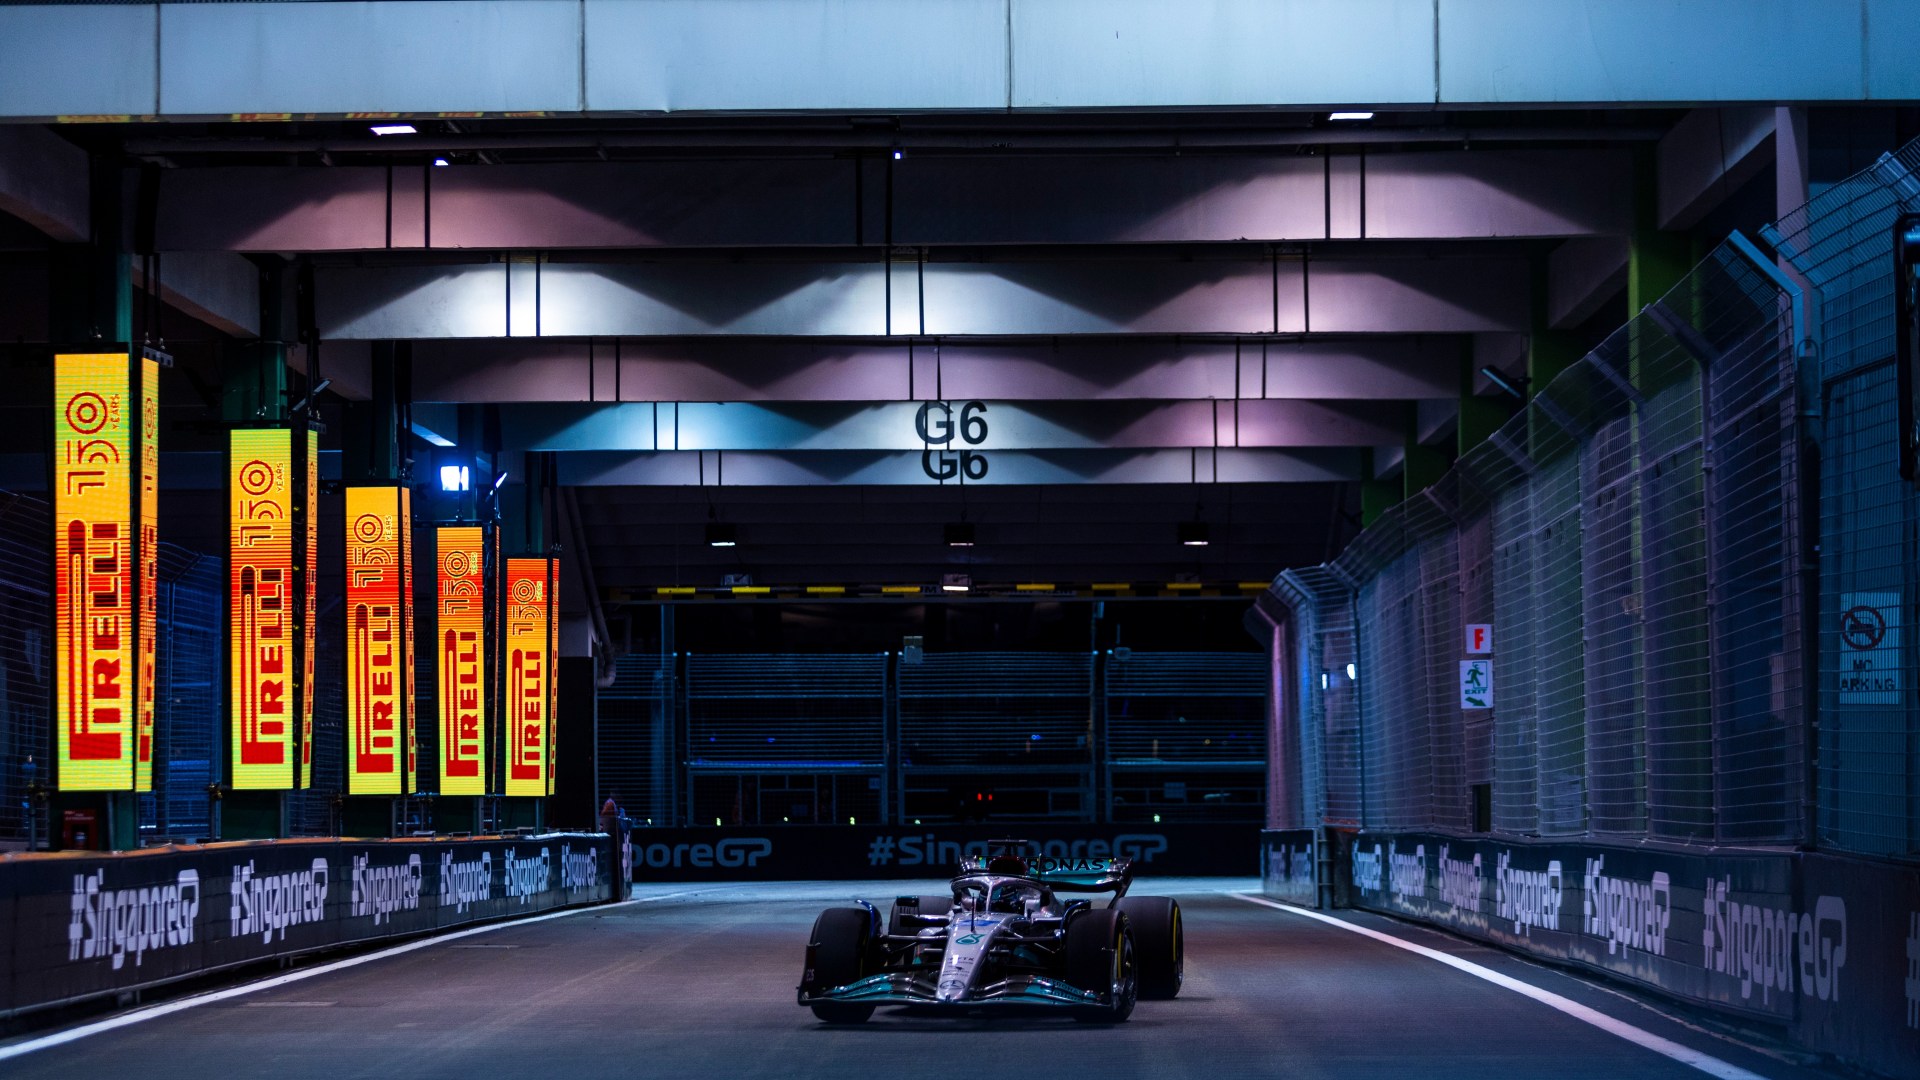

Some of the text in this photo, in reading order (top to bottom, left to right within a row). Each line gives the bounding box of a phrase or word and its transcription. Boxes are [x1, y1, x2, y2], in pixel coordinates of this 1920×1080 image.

[66, 391, 120, 495] 150
[109, 393, 121, 430] YEARS
[915, 401, 988, 445] G6
[275, 462, 285, 493] YEARS
[922, 450, 988, 480] G6
[68, 520, 122, 760] PIRELLI
[240, 459, 285, 764] PIRELLI 150
[353, 513, 393, 773] PIRELLI 150
[1475, 628, 1484, 650] F
[443, 550, 479, 776] PIRELLI 150
[511, 579, 542, 779] PIRELLI 150
[68, 867, 200, 970] #SingaporeGP
[231, 858, 328, 945] #SingaporeGP
[352, 851, 422, 926] #SingaporeGP
[440, 849, 492, 914] #SingaporeGP
[1496, 849, 1563, 937] #SingaporeGP
[1584, 853, 1671, 960] #SingaporeGP
[1703, 873, 1847, 1006] #SingaporeGP
